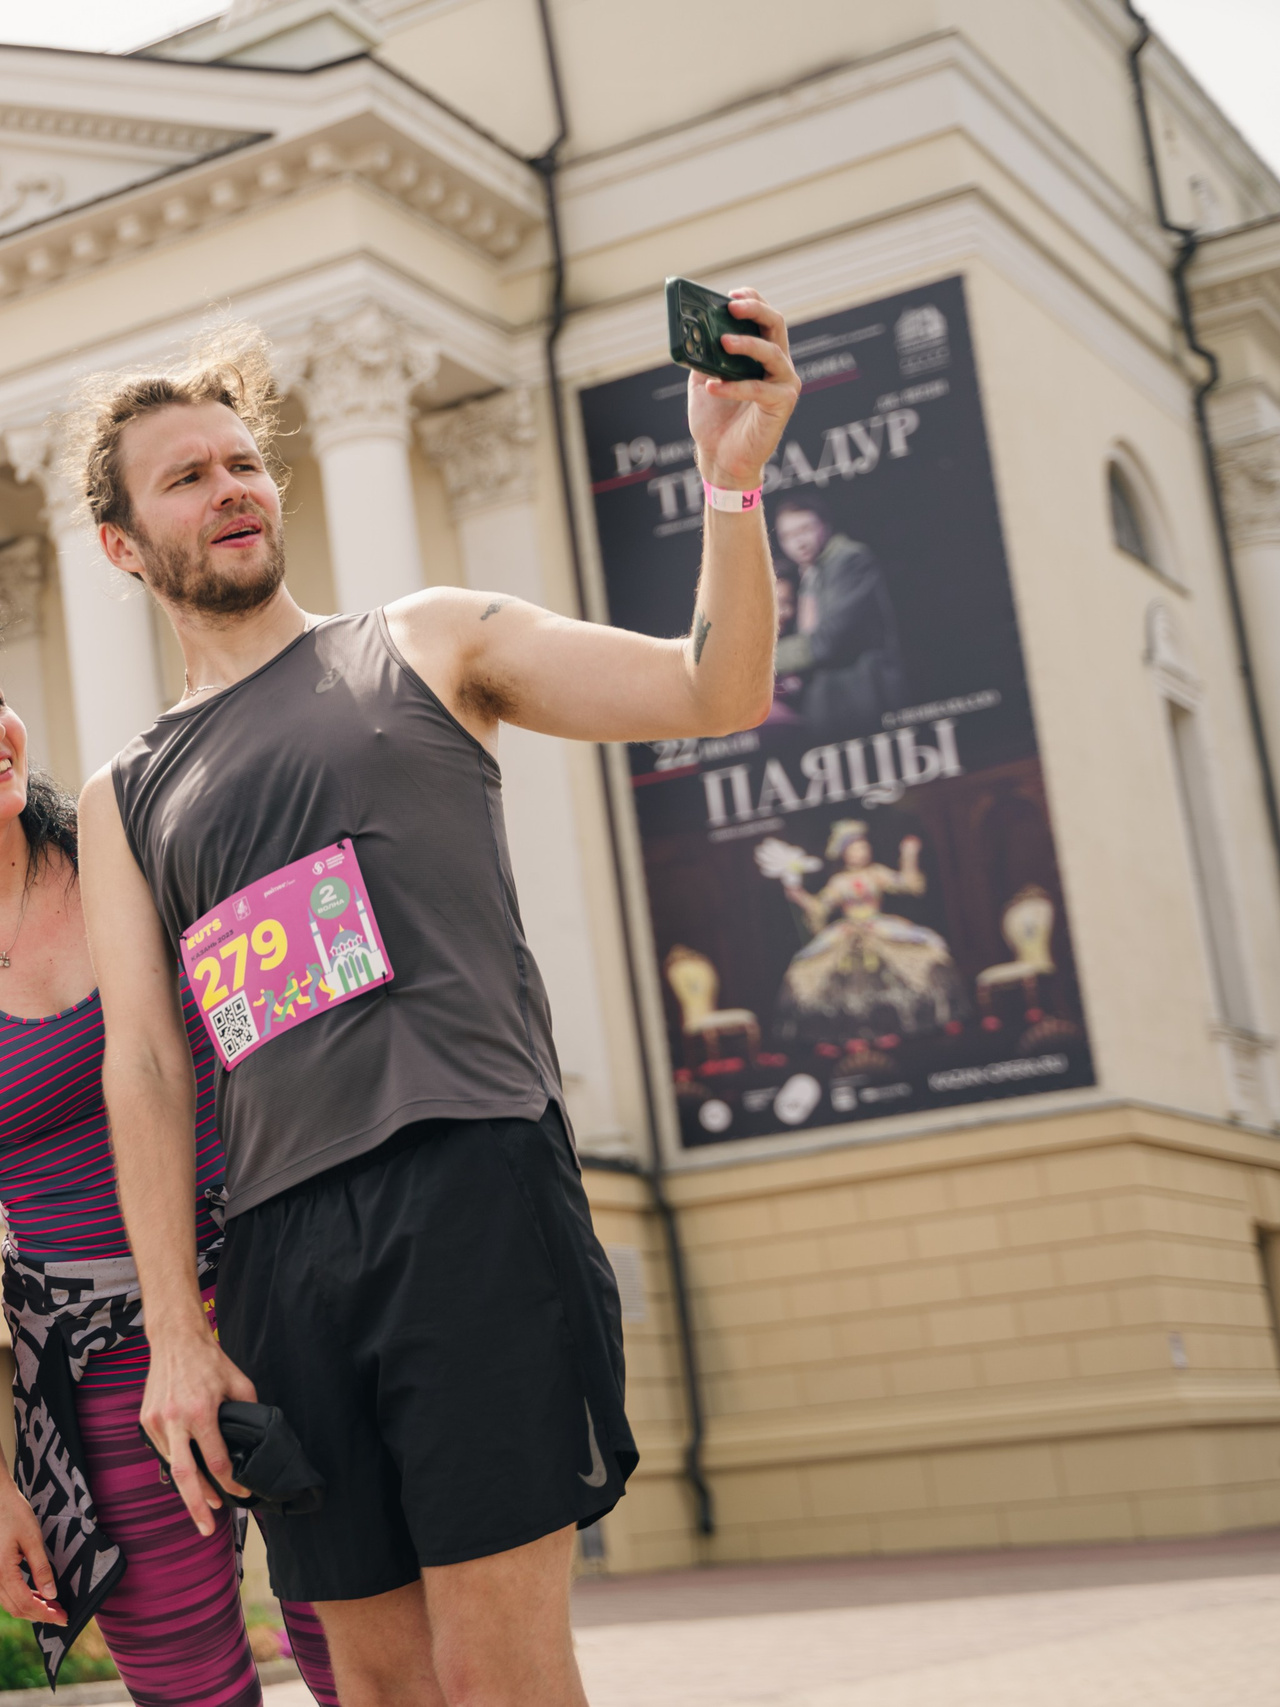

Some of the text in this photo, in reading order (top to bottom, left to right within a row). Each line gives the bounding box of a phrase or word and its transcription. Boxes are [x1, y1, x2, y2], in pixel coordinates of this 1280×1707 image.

[699, 717, 966, 829] ПАЯЦЫ
[317, 899, 345, 914] ВОЛНА
[319, 884, 338, 905] 2
[186, 918, 222, 951] RUTS
[191, 929, 234, 962] КАЗАНЬ 2023
[193, 918, 288, 1012] 279
